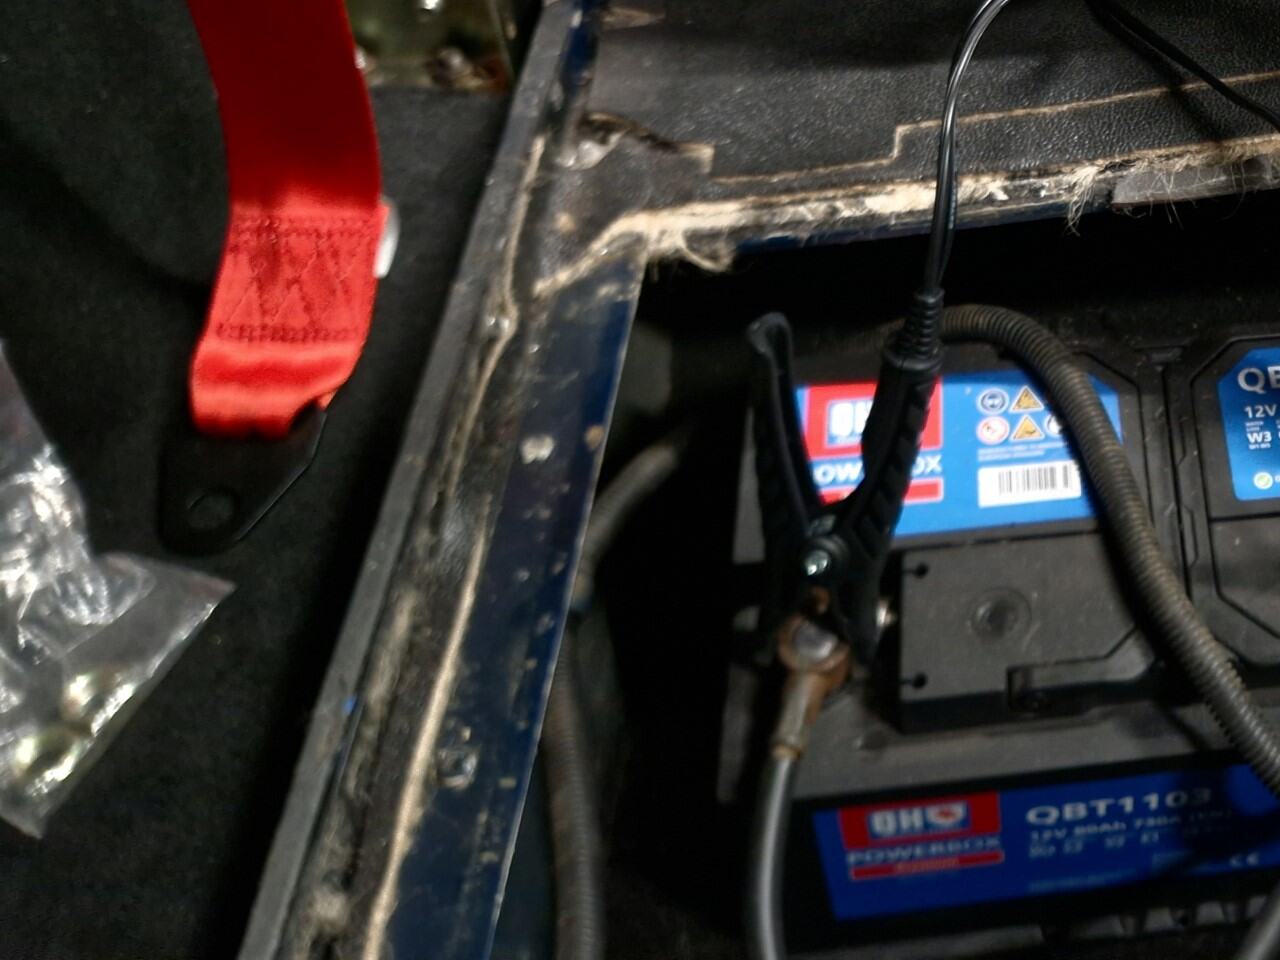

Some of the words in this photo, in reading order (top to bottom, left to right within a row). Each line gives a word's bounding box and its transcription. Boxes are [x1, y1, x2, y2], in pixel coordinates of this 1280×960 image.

[1244, 404, 1278, 419] 12V
[1247, 431, 1272, 444] W3
[1026, 788, 1212, 826] QBT1103
[847, 836, 1001, 865] POWERBOX
